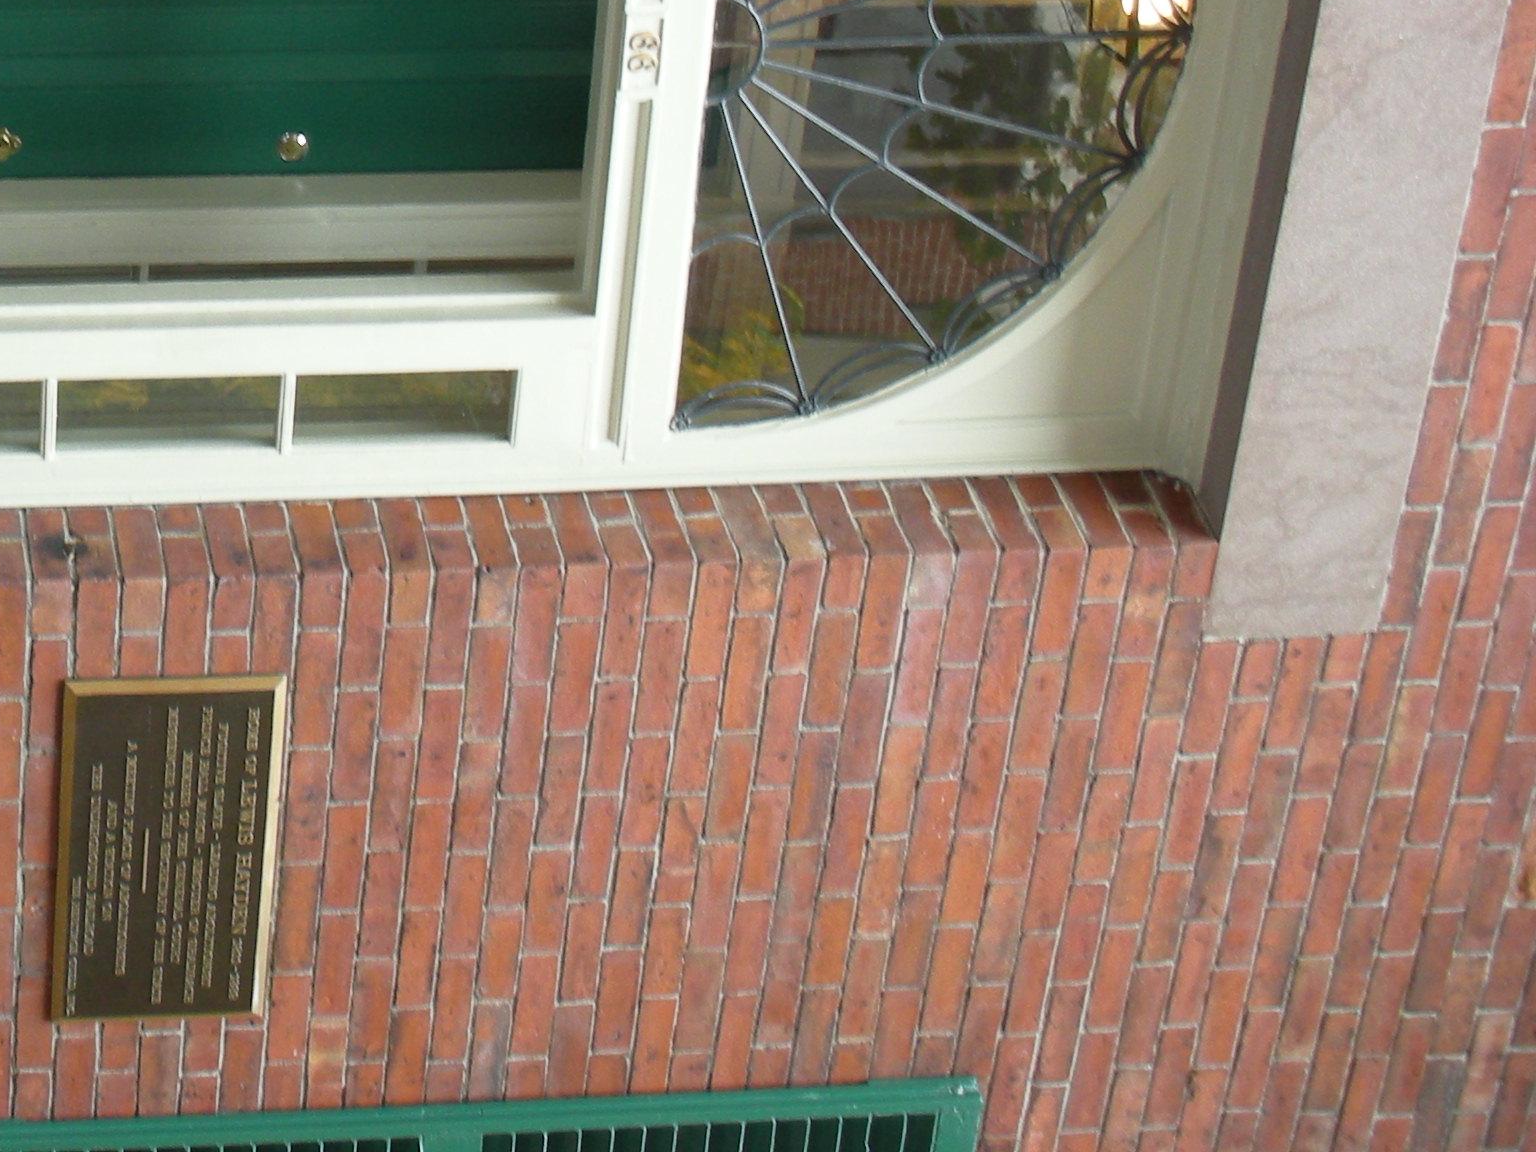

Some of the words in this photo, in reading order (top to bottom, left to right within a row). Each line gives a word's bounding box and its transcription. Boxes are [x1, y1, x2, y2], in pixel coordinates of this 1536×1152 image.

[627, 32, 661, 73] 66
[127, 740, 138, 753] A
[165, 707, 179, 788] MESSENGER
[200, 706, 213, 757] PRINCE
[246, 707, 260, 751] HOME
[215, 722, 229, 785] FUGITIVE
[245, 754, 257, 776] OF
[91, 762, 103, 791] THE
[124, 754, 137, 815] MEETING
[180, 750, 193, 807] MEMBER
[198, 759, 209, 796] HALL
[106, 799, 118, 829] AND
[162, 791, 174, 809] TO
[179, 809, 189, 828] OF
[212, 788, 224, 830] SLAVE
[238, 780, 257, 845] LEWIS
[106, 832, 116, 844] A
[121, 817, 133, 861] PLACE
[161, 812, 172, 839] THE
[195, 798, 207, 844] MASON
[87, 796, 101, 891] UNDERGROUND
[177, 831, 188, 858] THE
[72, 876, 82, 898] THE
[102, 846, 115, 899] STATION
[120, 862, 131, 880] OF
[157, 841, 171, 915] SECRETARY
[173, 861, 186, 922] GENERAL
[207, 843, 221, 901] LEADING
[102, 902, 112, 921] ON
[231, 852, 253, 935] HAYDEN
[83, 892, 96, 956] RAILROAD
[115, 883, 129, 977] ABOLITIONISTS
[156, 918, 166, 935] OF
[170, 924, 182, 964] COURT
[188, 917, 199, 934] OF
[153, 938, 164, 964] THE
[201, 904, 216, 987] ABOLITIONIST
[151, 966, 163, 1004] STATE
